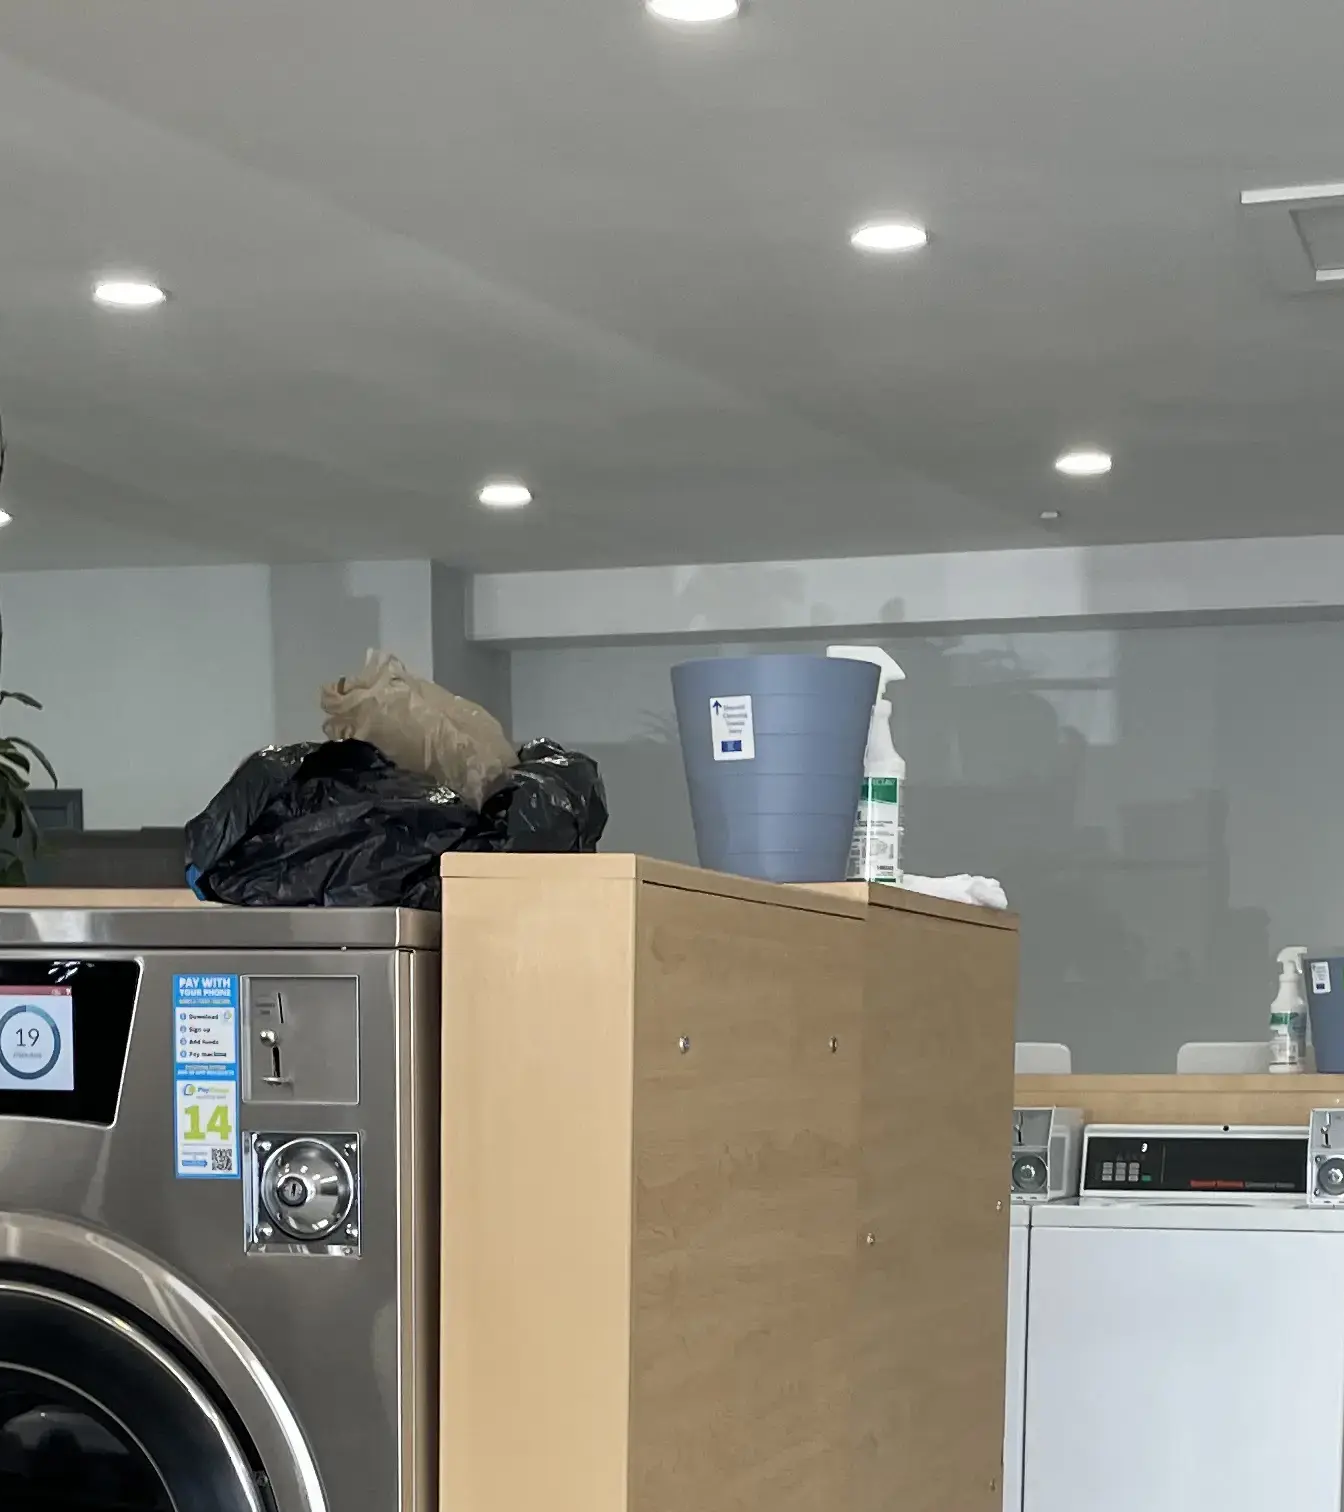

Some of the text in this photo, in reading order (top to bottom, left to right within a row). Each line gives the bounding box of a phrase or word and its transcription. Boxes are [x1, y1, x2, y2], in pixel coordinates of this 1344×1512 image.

[179, 977, 231, 989] PAY WITH
[179, 988, 232, 997] YOUR PHONE
[15, 1028, 40, 1048] 19
[183, 1104, 232, 1141] 14
